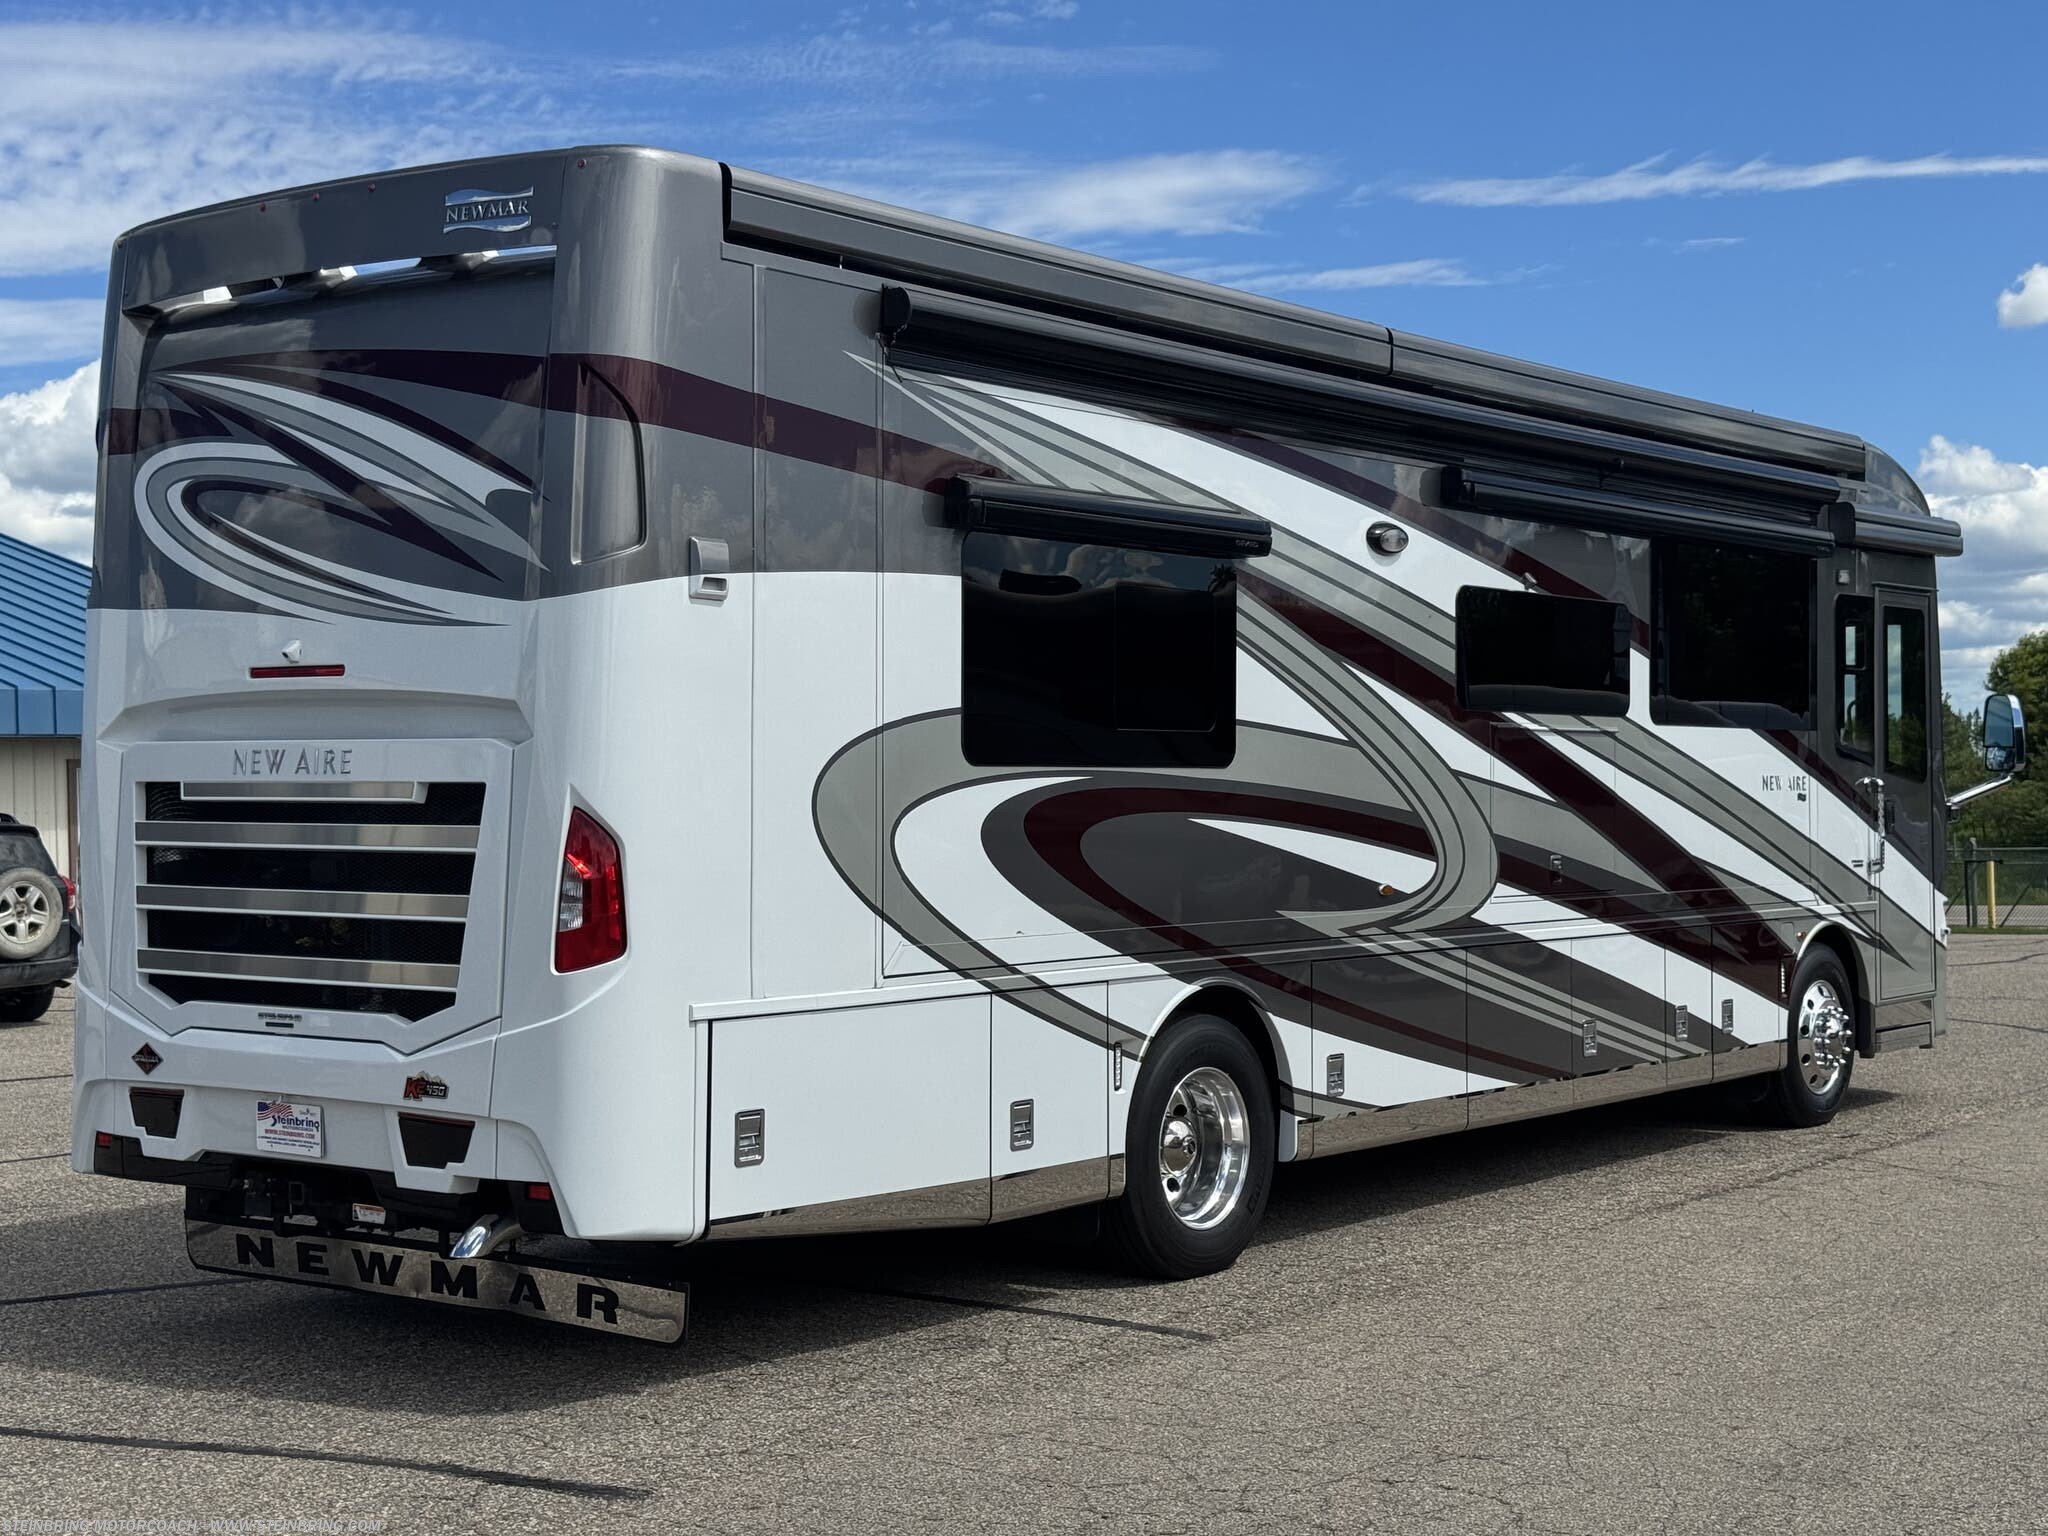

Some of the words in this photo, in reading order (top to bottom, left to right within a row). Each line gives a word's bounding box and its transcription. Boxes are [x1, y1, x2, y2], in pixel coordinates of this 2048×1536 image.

[446, 200, 529, 222] NEWMAR
[233, 748, 286, 776] NEW
[294, 748, 353, 776] AIRE
[1761, 775, 1782, 792] NEW
[1787, 775, 1807, 792] AIRE
[235, 1233, 619, 1325] NEWMAR
